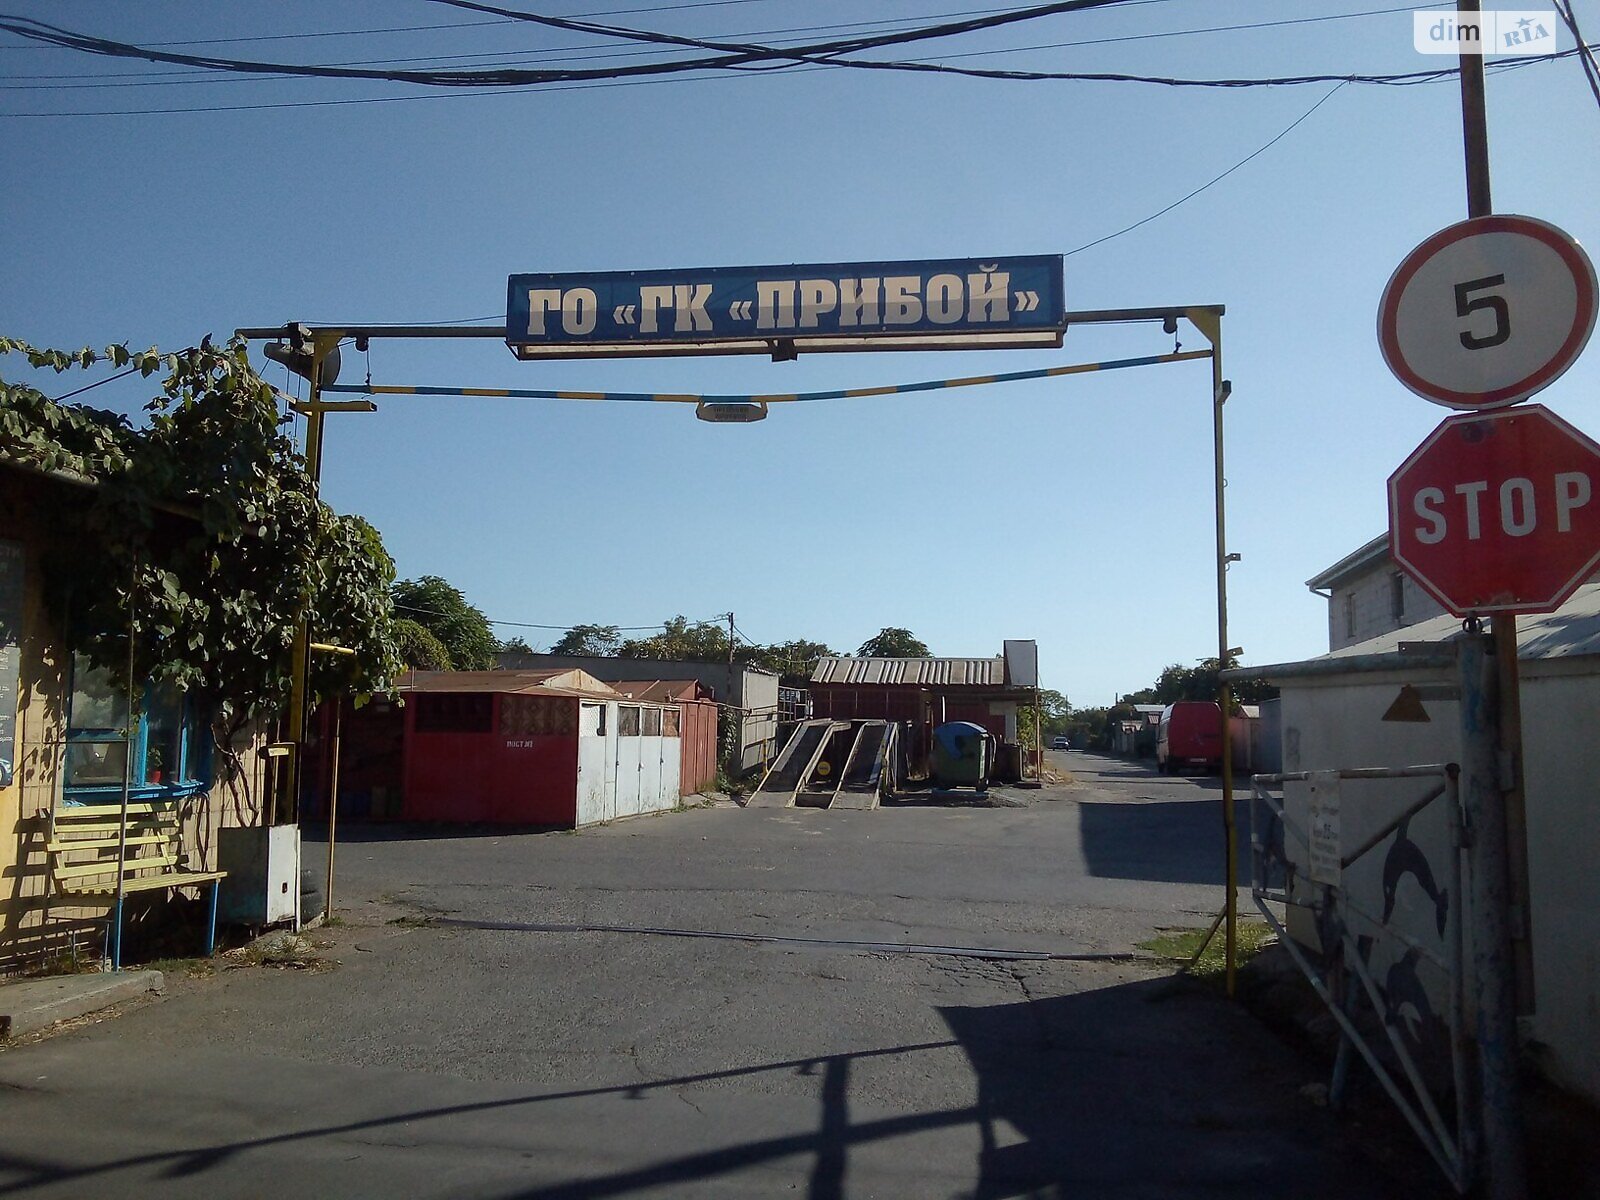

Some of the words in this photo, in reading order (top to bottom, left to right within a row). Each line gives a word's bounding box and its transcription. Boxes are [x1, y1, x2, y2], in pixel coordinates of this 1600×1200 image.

[526, 287, 598, 335] ГО
[613, 284, 714, 332] «ГК
[729, 263, 1040, 329] «ПРИБОЙ»
[1454, 273, 1510, 350] 5
[1413, 471, 1591, 545] STOP
